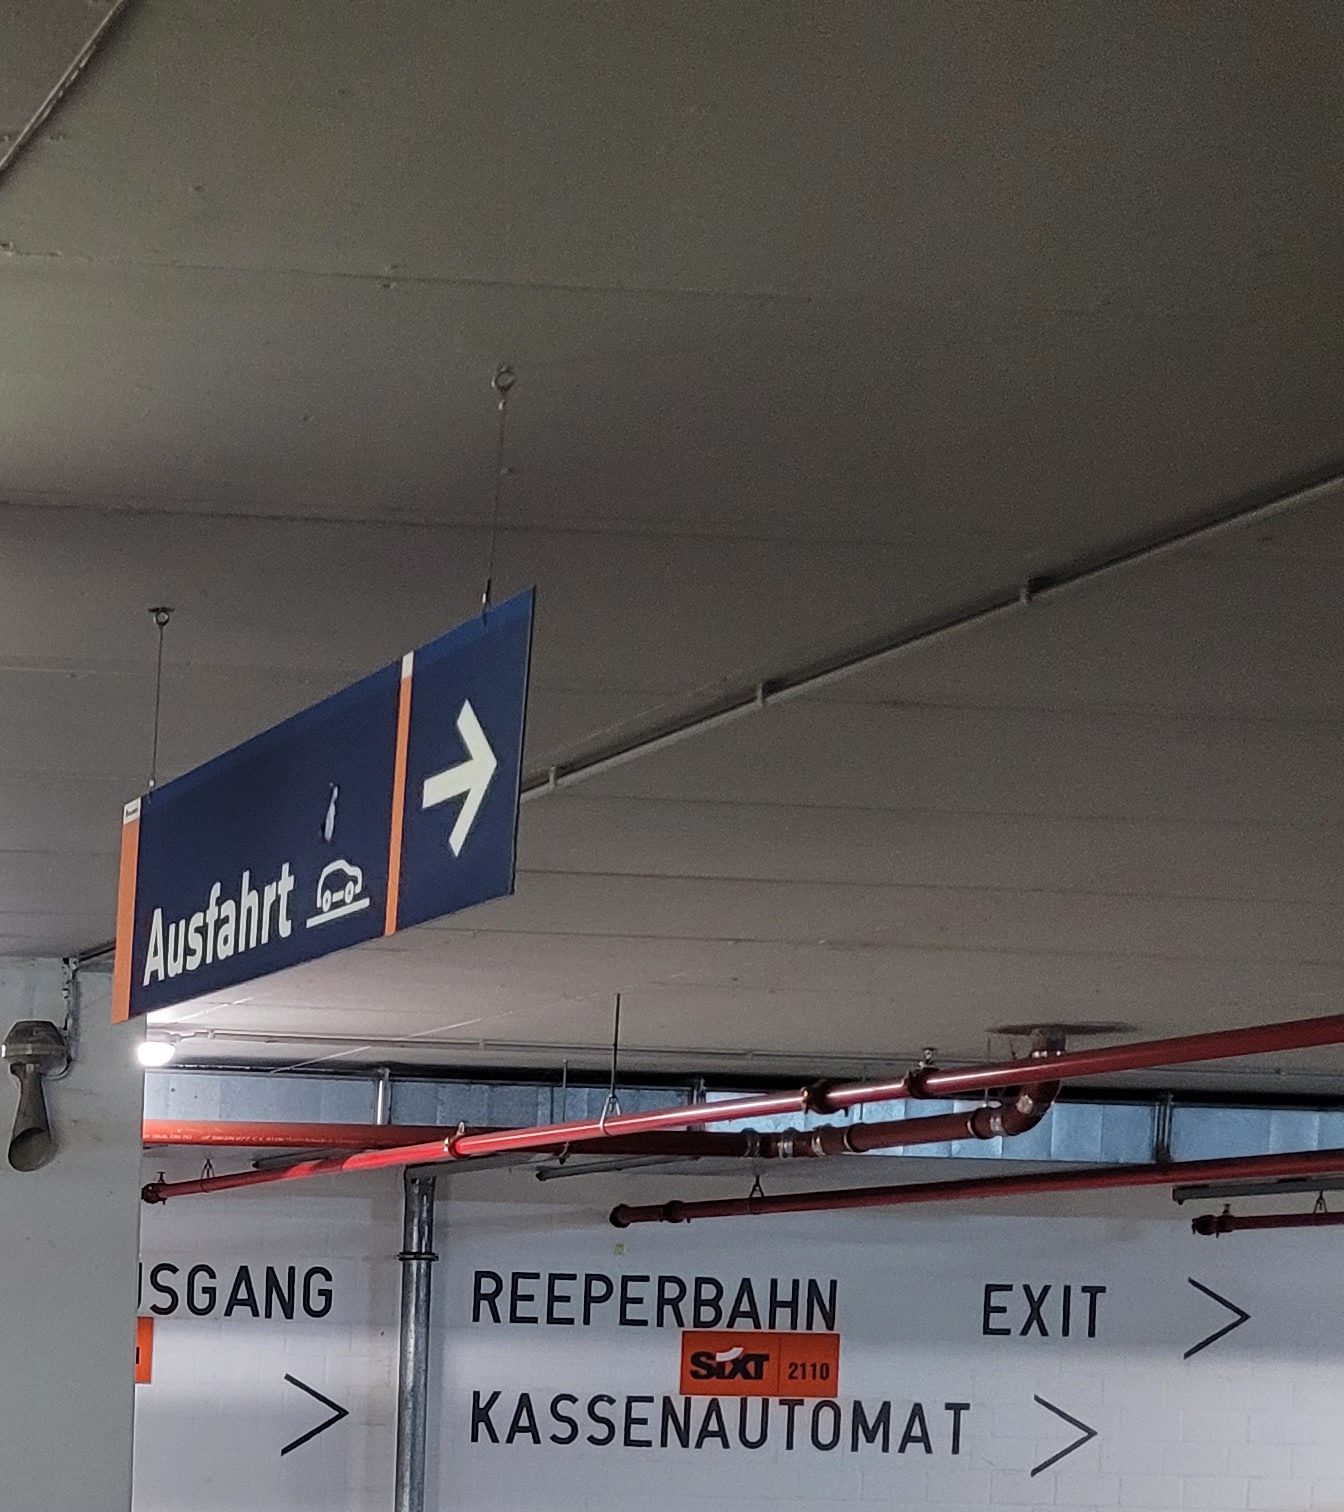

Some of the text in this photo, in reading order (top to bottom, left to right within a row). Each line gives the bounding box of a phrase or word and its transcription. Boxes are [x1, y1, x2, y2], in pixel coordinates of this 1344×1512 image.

[143, 862, 295, 986] Ausfahrt
[472, 1270, 838, 1331] REEPERBAHN
[982, 1283, 1107, 1339] EXIT
[787, 1362, 830, 1381] 2110
[470, 1390, 971, 1456] KASSENAUTOMAT
